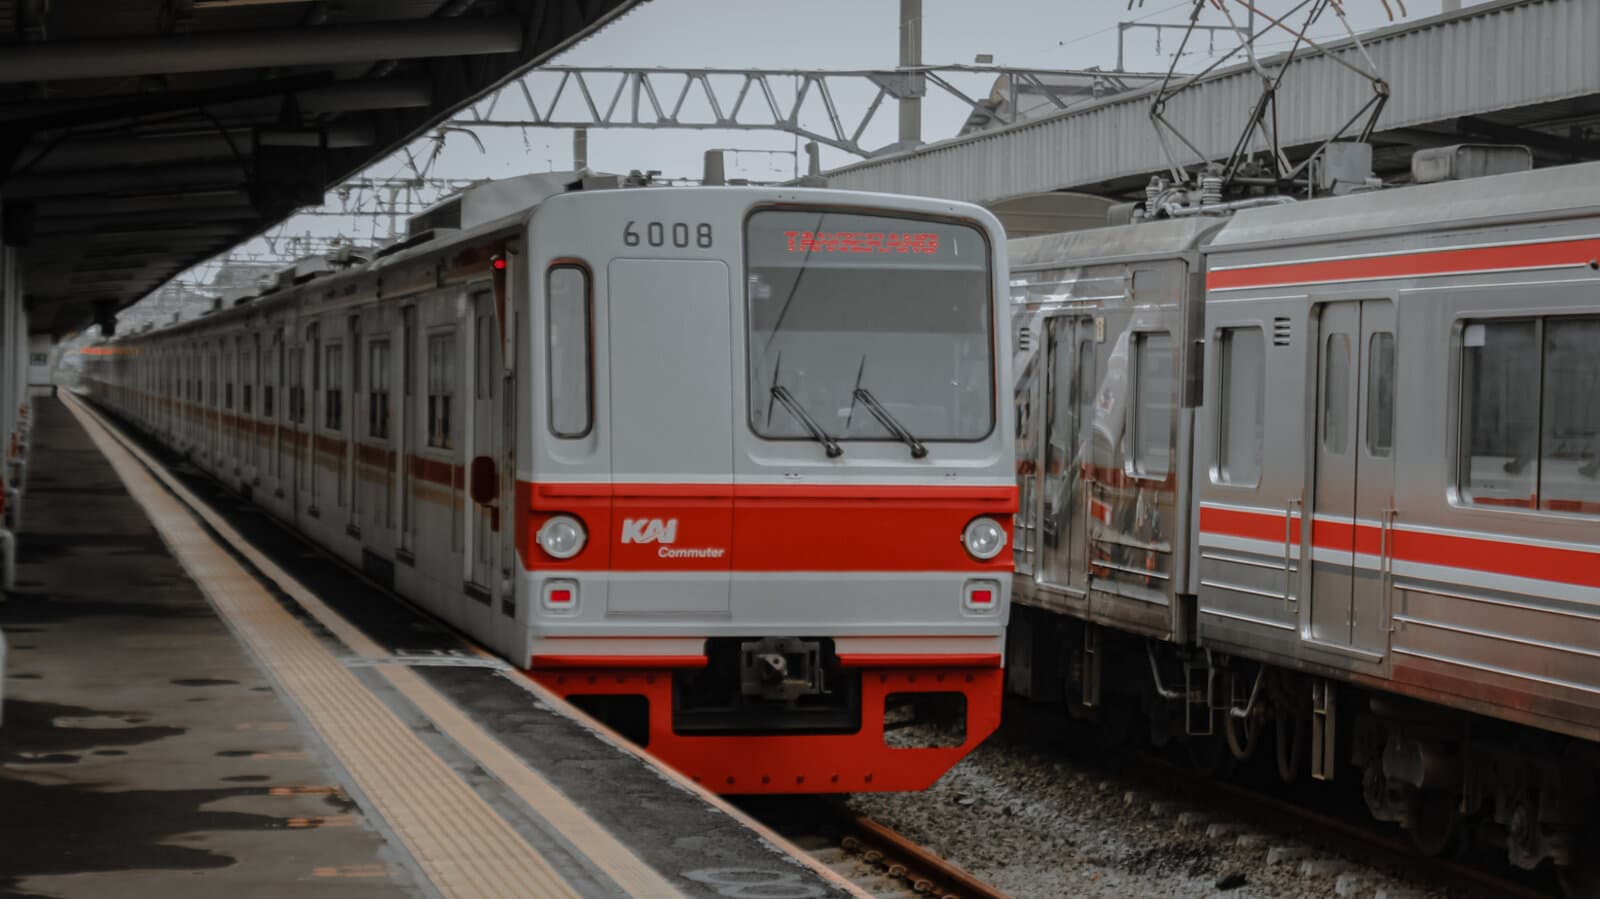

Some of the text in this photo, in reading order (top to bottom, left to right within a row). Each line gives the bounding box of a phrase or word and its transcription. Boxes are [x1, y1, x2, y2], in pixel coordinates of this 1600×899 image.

[623, 220, 713, 249] 6008
[621, 518, 678, 544] KAI
[658, 546, 725, 558] Commuter
